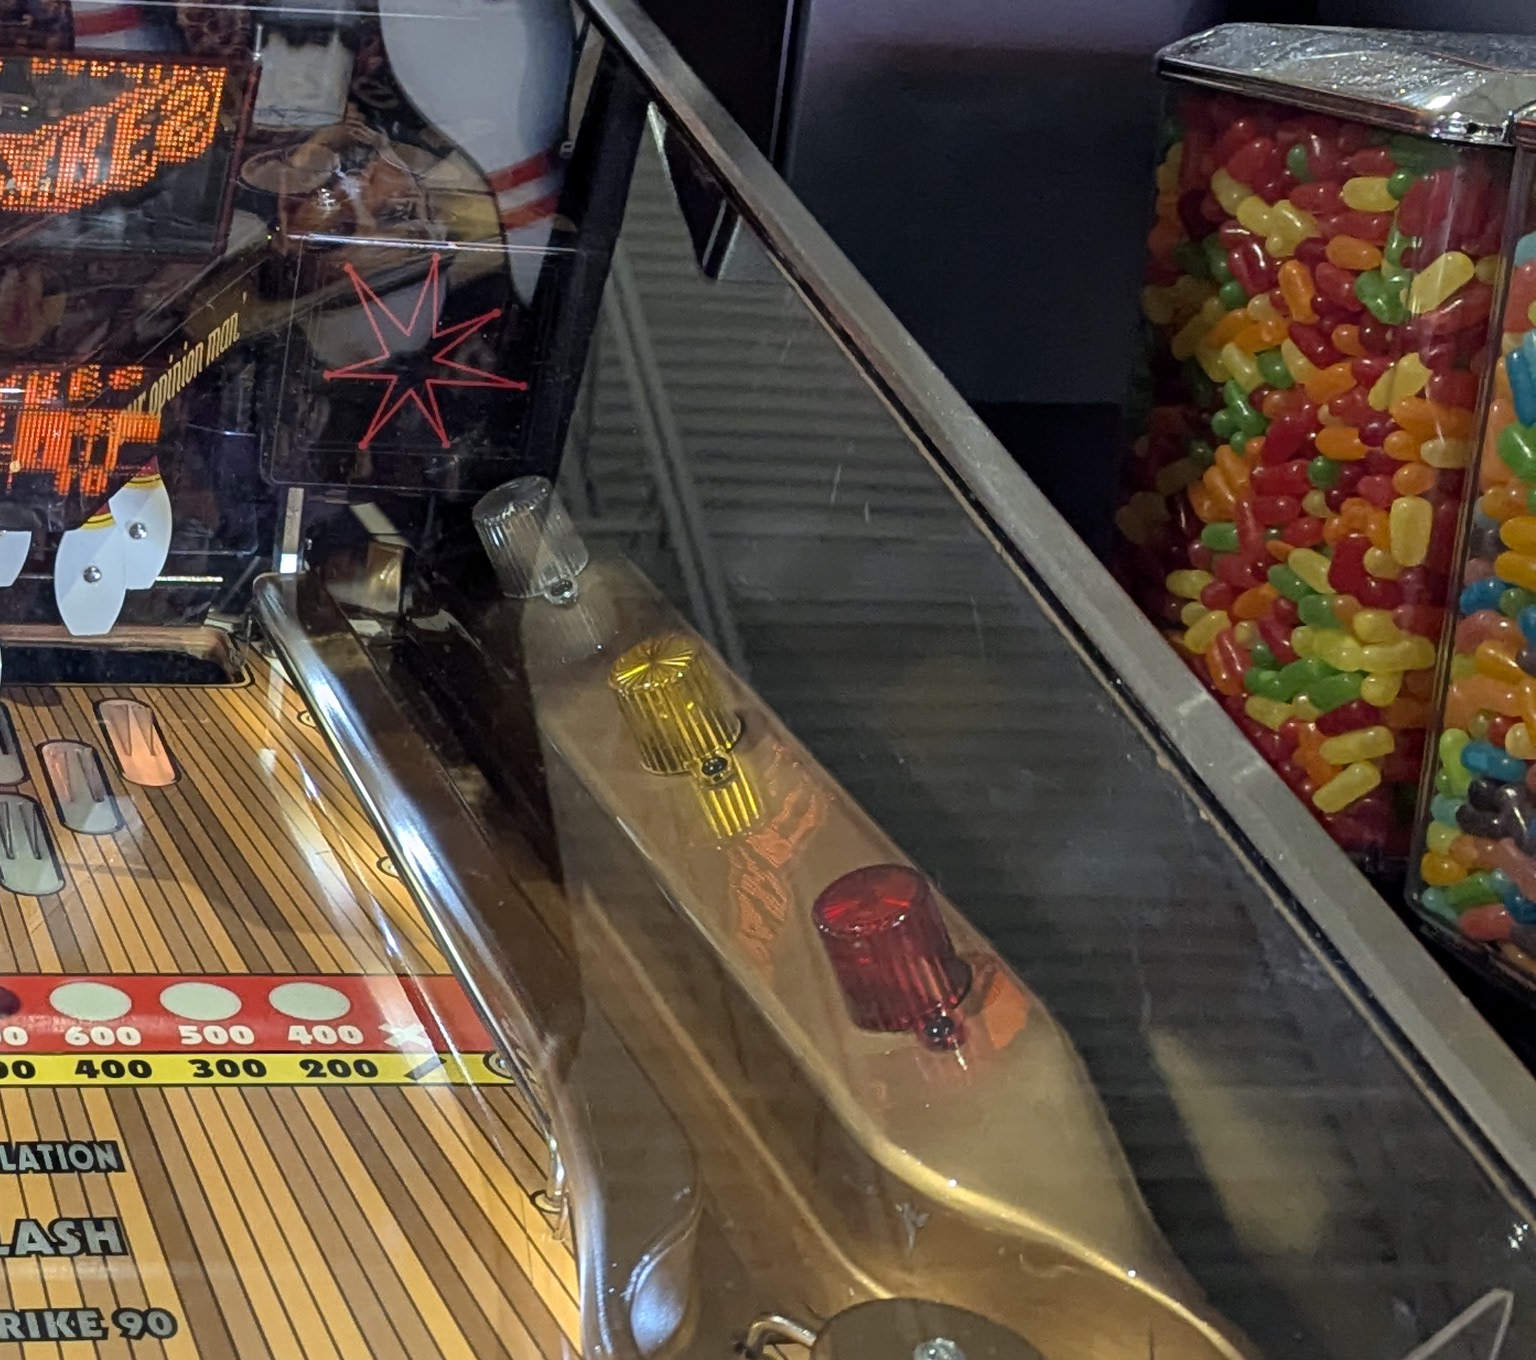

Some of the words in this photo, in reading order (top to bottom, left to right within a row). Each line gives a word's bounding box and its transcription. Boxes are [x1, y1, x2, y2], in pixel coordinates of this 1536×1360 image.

[64, 1026, 142, 1047] 600
[178, 1025, 256, 1046] 500
[287, 1024, 365, 1046] 400
[74, 1059, 153, 1080] 400
[187, 1058, 268, 1080] 300
[298, 1058, 380, 1079] 200
[116, 1309, 175, 1339] 90
